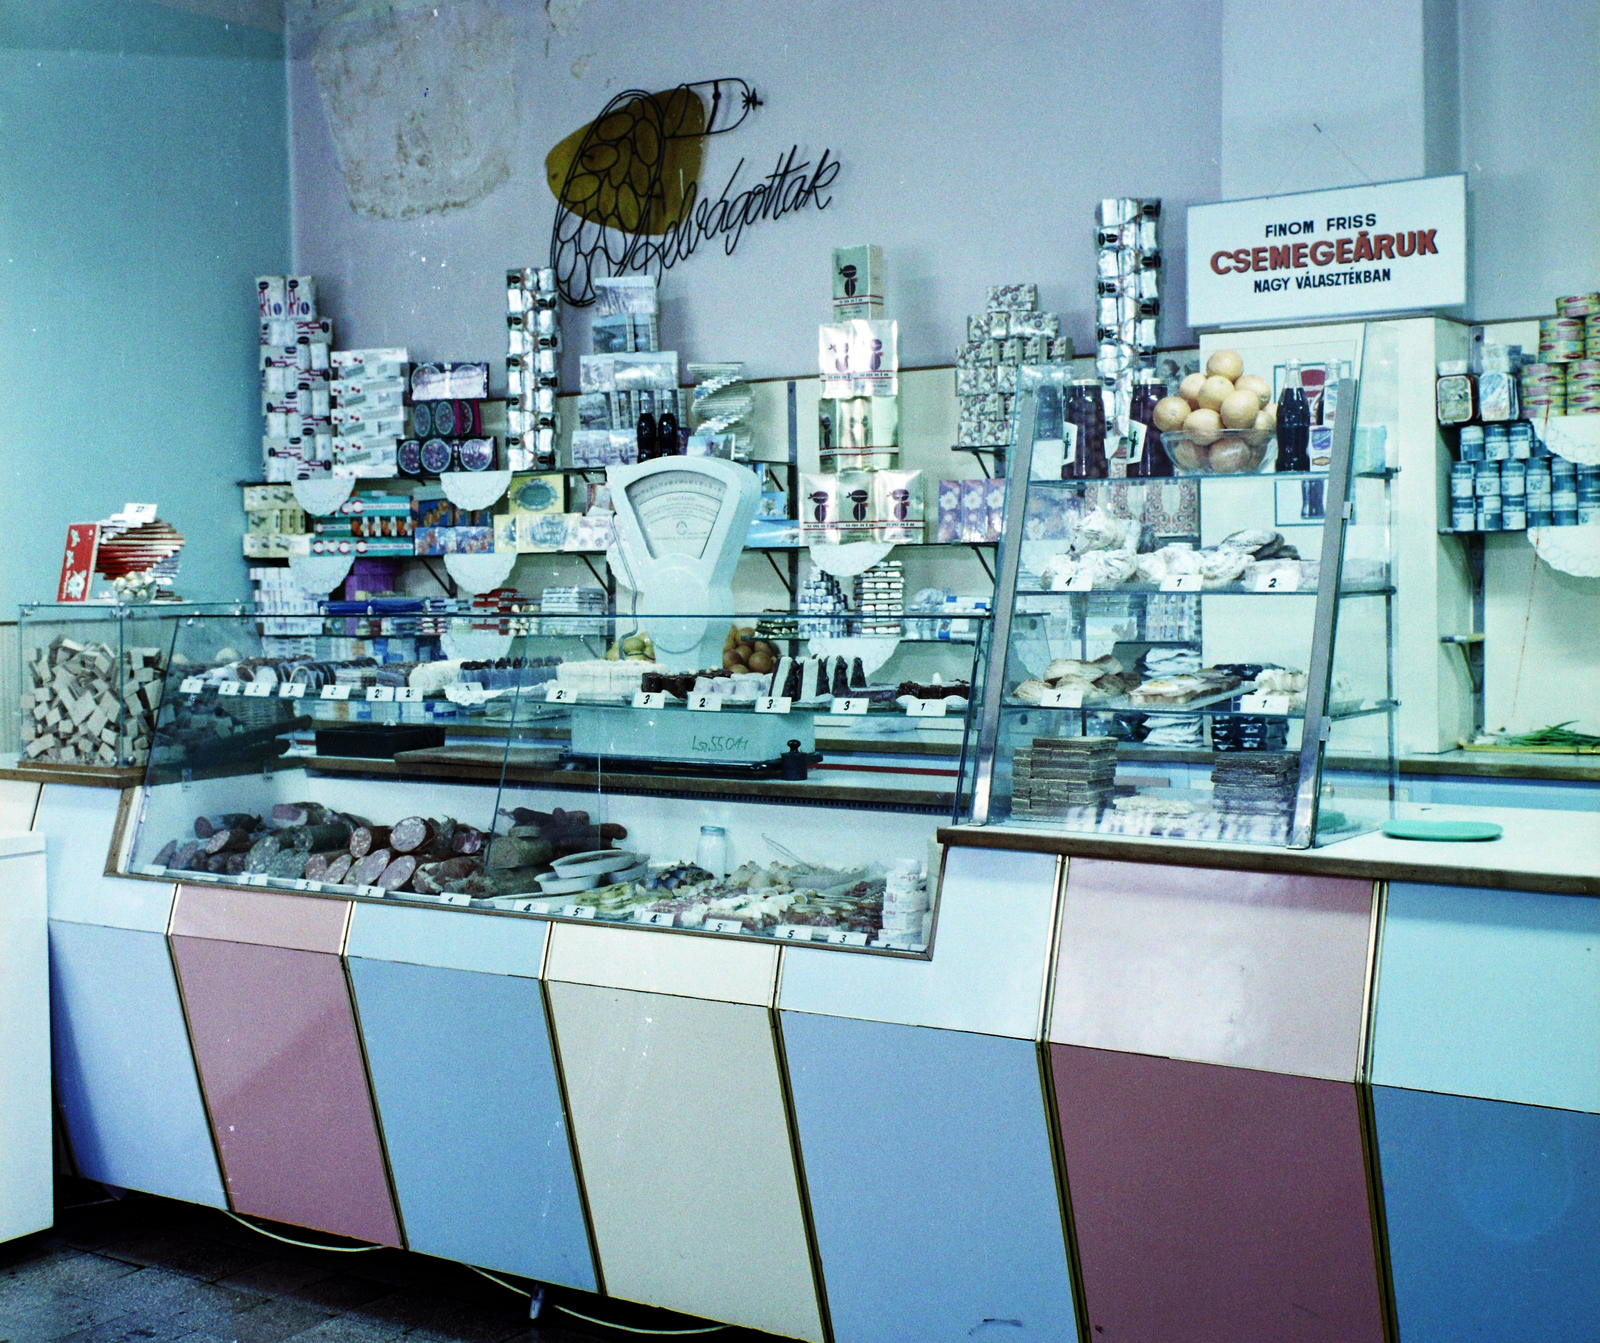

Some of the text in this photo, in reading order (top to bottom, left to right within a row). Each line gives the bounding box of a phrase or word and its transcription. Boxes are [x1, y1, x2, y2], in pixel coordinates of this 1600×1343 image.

[1265, 213, 1377, 238] FINOM FRISS
[1253, 267, 1391, 293] NAGY VÁLASZTÉKBAN
[1268, 577, 1277, 588] 2
[556, 690, 564, 699] 2
[643, 694, 651, 704] 3
[699, 697, 706, 708] 2
[767, 699, 774, 709] 3
[843, 701, 851, 711] 3
[839, 934, 847, 943] 3
